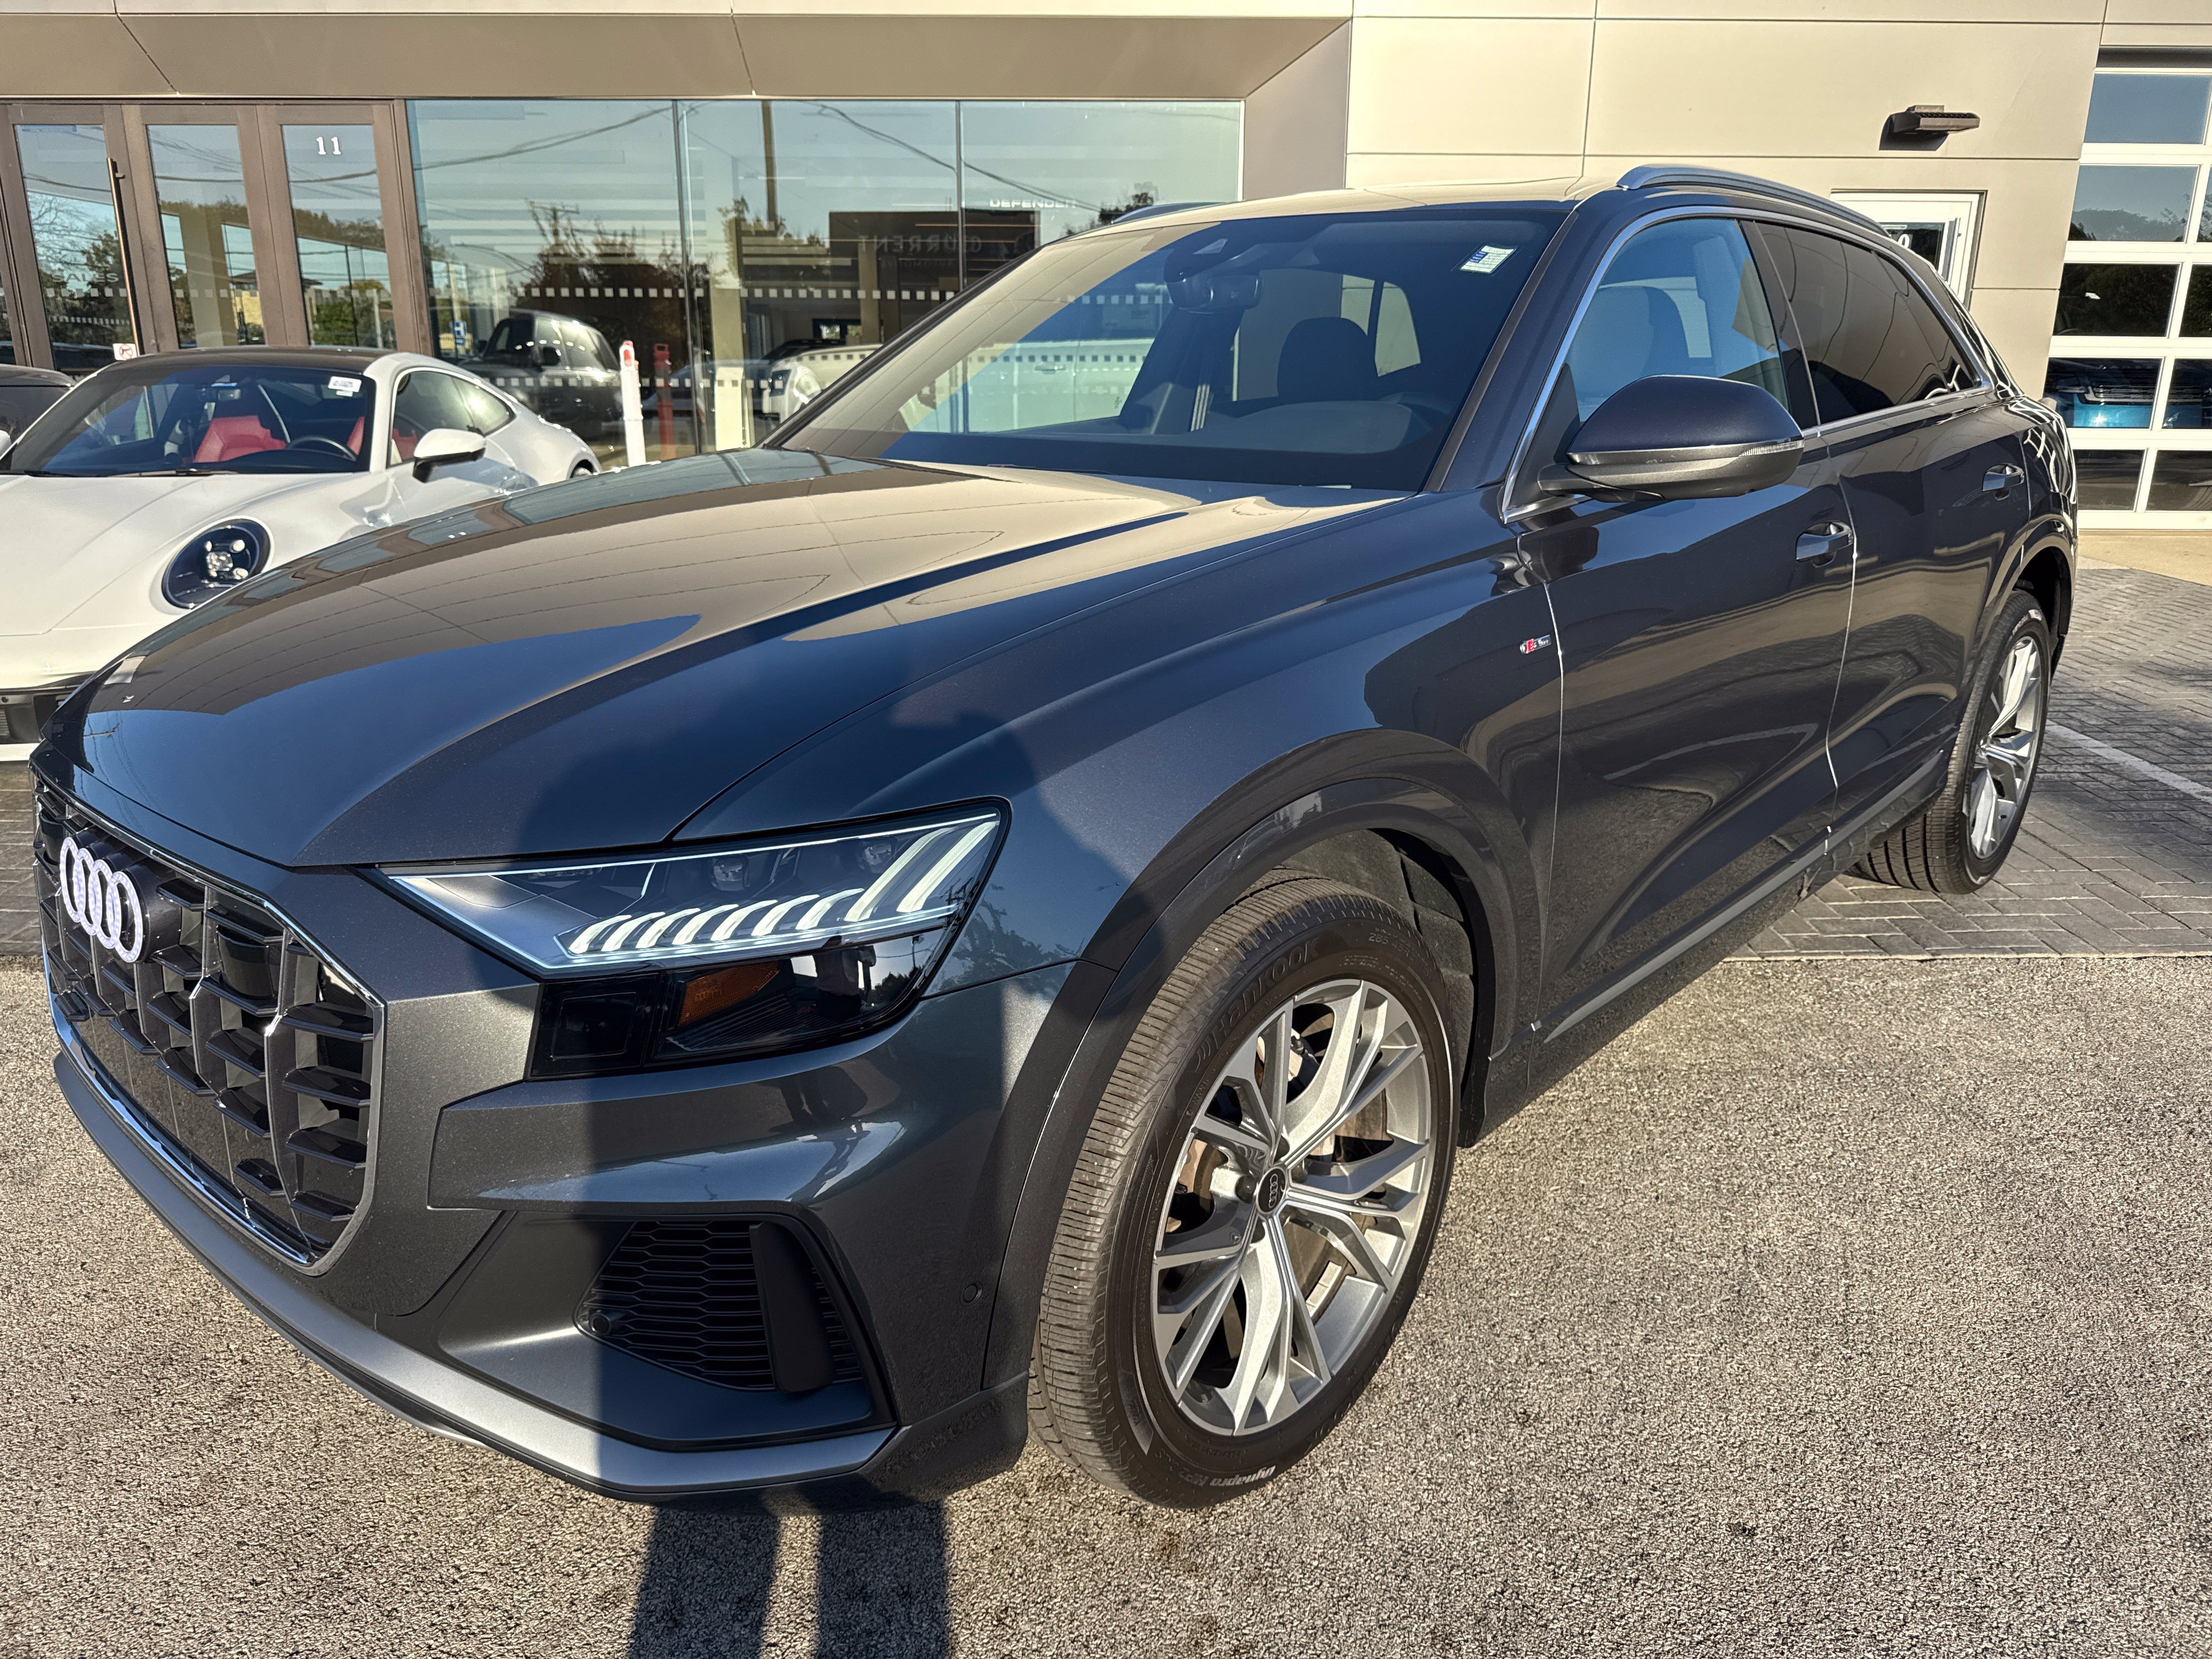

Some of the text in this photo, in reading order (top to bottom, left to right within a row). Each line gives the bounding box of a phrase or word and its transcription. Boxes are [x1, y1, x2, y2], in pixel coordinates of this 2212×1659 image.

[315, 136, 342, 156] 11
[990, 199, 1076, 208] DEFENDER
[52, 273, 119, 283] SALES
[1209, 1464, 1276, 1487] Dynapro
